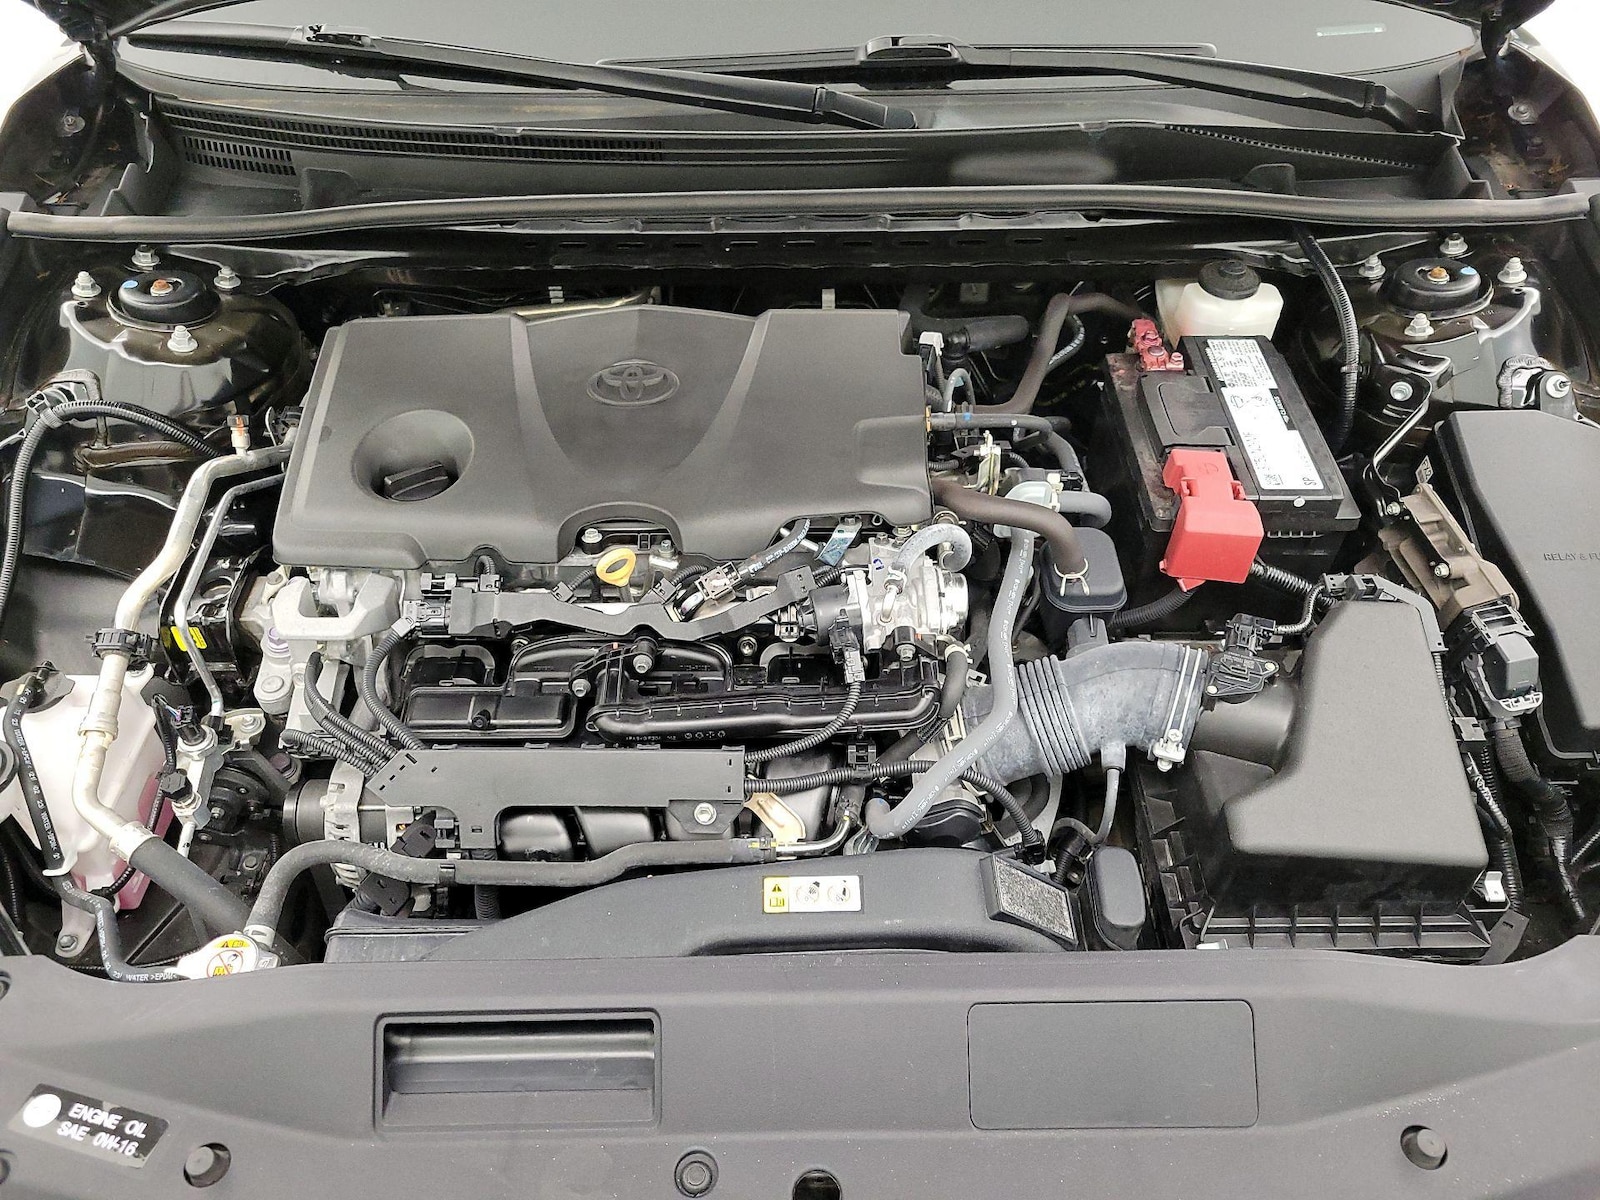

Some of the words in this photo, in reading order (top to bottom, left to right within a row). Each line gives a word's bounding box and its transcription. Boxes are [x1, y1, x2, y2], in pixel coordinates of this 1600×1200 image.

[1543, 552, 1576, 561] RELAY
[125, 973, 149, 982] WATER
[68, 1102, 123, 1130] ENGINE
[124, 1119, 149, 1139] OIL
[57, 1121, 91, 1142] SAE
[92, 1132, 139, 1157] 0W-16
